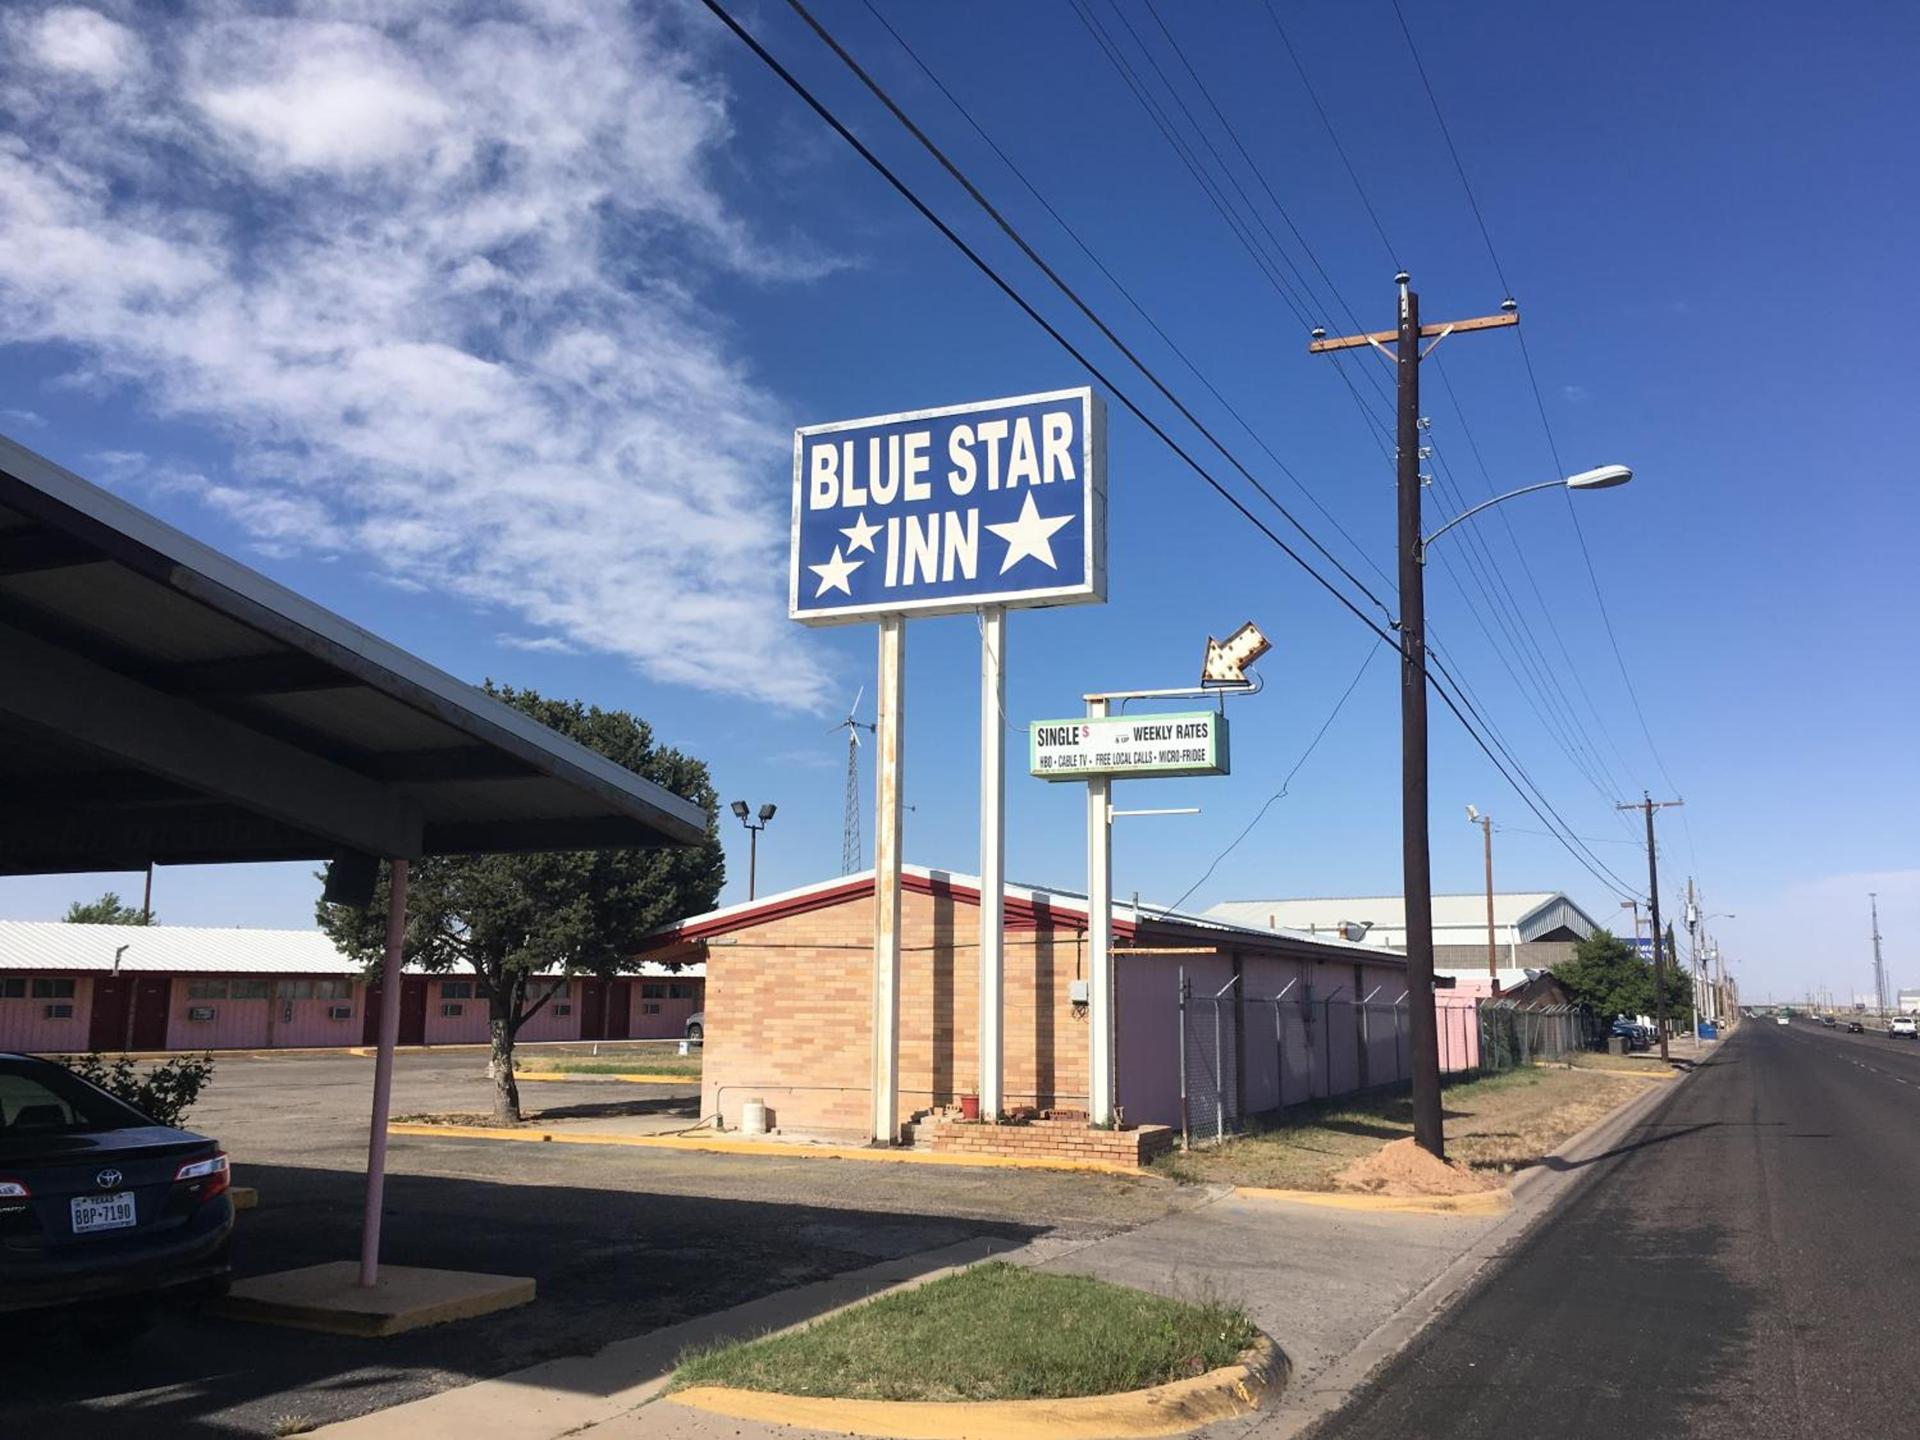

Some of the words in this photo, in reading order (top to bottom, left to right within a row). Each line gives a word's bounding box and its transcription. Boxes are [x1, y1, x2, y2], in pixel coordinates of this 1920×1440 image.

[809, 431, 931, 510] BLUE
[948, 412, 1076, 496] STAR
[885, 508, 979, 588] INN
[1038, 727, 1079, 747] SINGLE
[1134, 725, 1173, 742] WEEKLY
[1175, 722, 1208, 740] RATES
[1039, 756, 1053, 768] HBO
[1057, 754, 1077, 767] CABLE
[1079, 752, 1088, 766] TV
[1095, 752, 1111, 765] FREE
[1112, 750, 1132, 765] LOCAL
[1134, 748, 1153, 764] CALLS
[1158, 747, 1206, 763] MICRO-FRIDGE
